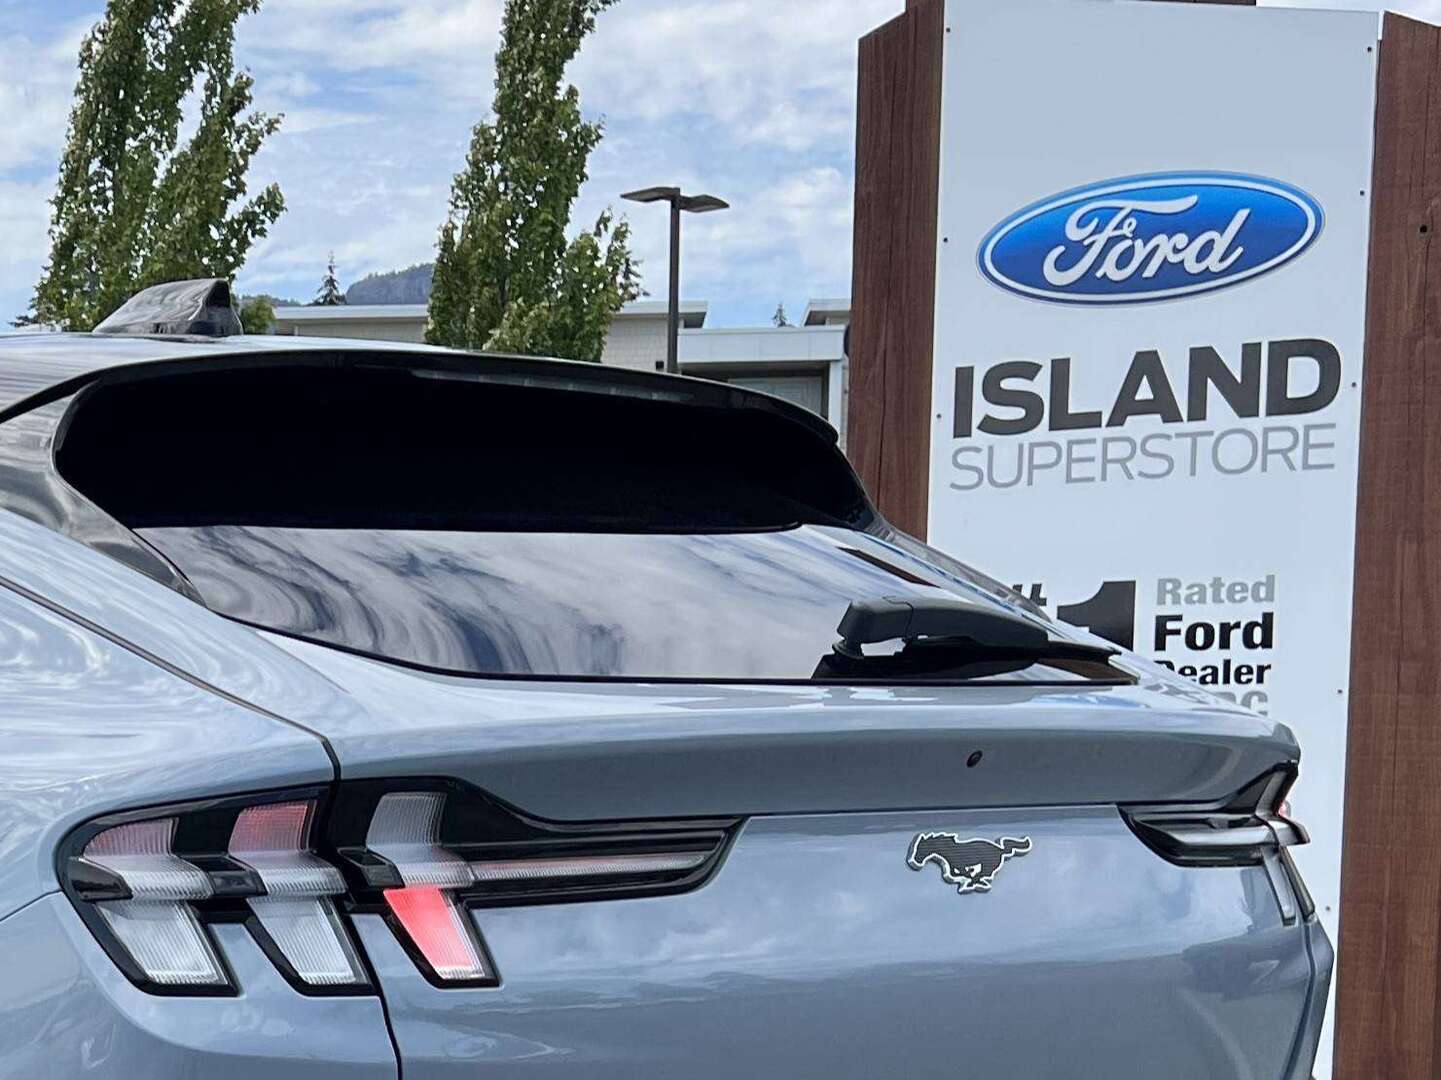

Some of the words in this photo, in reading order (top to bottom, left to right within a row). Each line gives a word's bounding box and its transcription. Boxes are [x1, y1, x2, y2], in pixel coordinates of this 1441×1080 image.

[1043, 194, 1250, 286] Ford
[953, 338, 1341, 438] ISLAND
[950, 423, 1336, 490] SUPERSTORE
[1157, 575, 1275, 605] Rated
[1154, 612, 1273, 651] Ford
